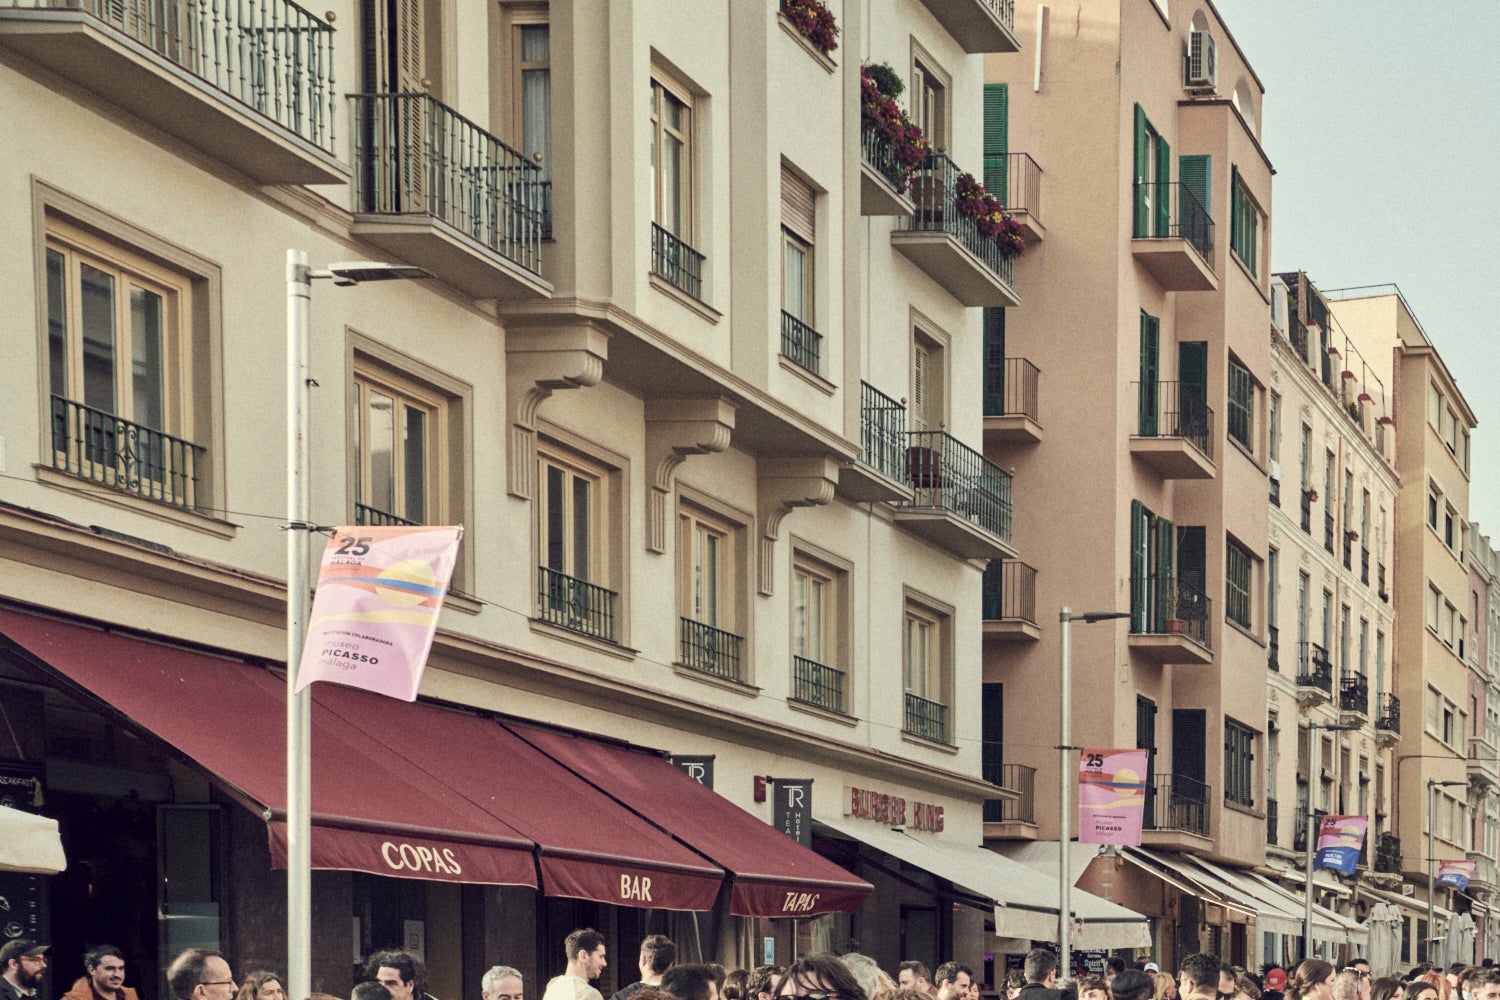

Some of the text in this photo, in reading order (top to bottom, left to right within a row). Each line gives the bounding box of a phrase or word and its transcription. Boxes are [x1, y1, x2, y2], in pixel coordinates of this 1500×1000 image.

[334, 537, 373, 556] 25
[321, 649, 379, 665] PICASSO
[1086, 753, 1103, 768] 25
[851, 787, 945, 833] BURGER KING
[381, 841, 462, 875] COPAS
[621, 873, 653, 902] BAR
[782, 891, 820, 912] TAPAS
